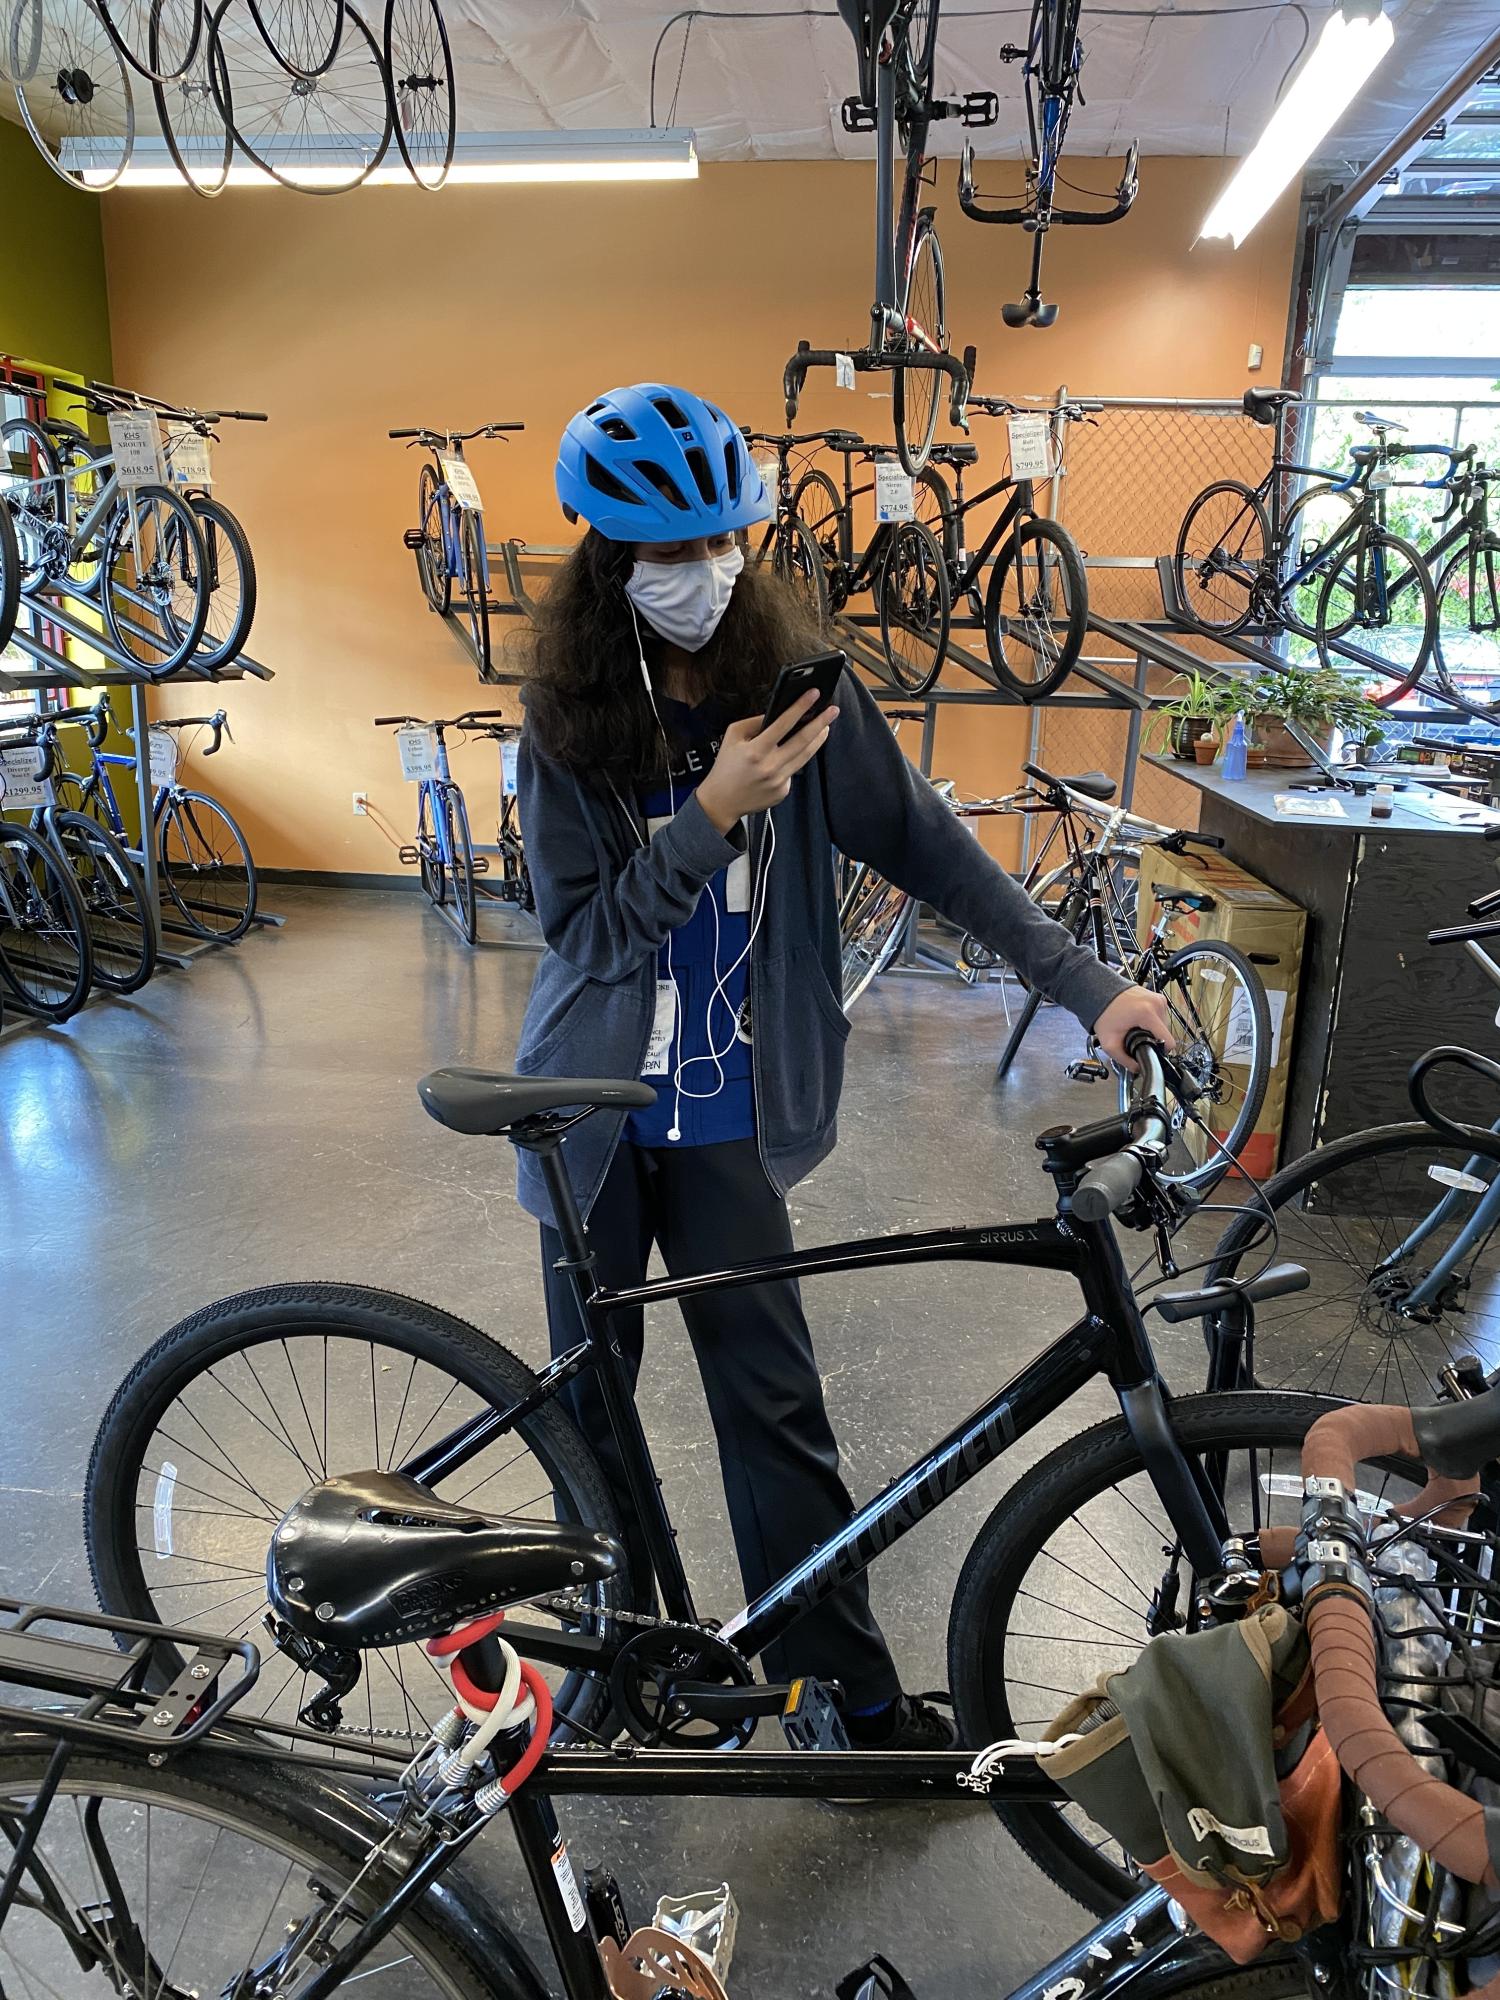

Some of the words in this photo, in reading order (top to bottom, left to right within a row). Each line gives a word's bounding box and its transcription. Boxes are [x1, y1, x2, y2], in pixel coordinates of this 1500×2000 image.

[121, 465, 154, 474] $618.95
[880, 504, 908, 512] $774.95
[5, 785, 42, 797] $1299.95
[980, 1230, 1025, 1244] SIRRUS
[782, 1402, 1017, 1608] SPECIALIZED
